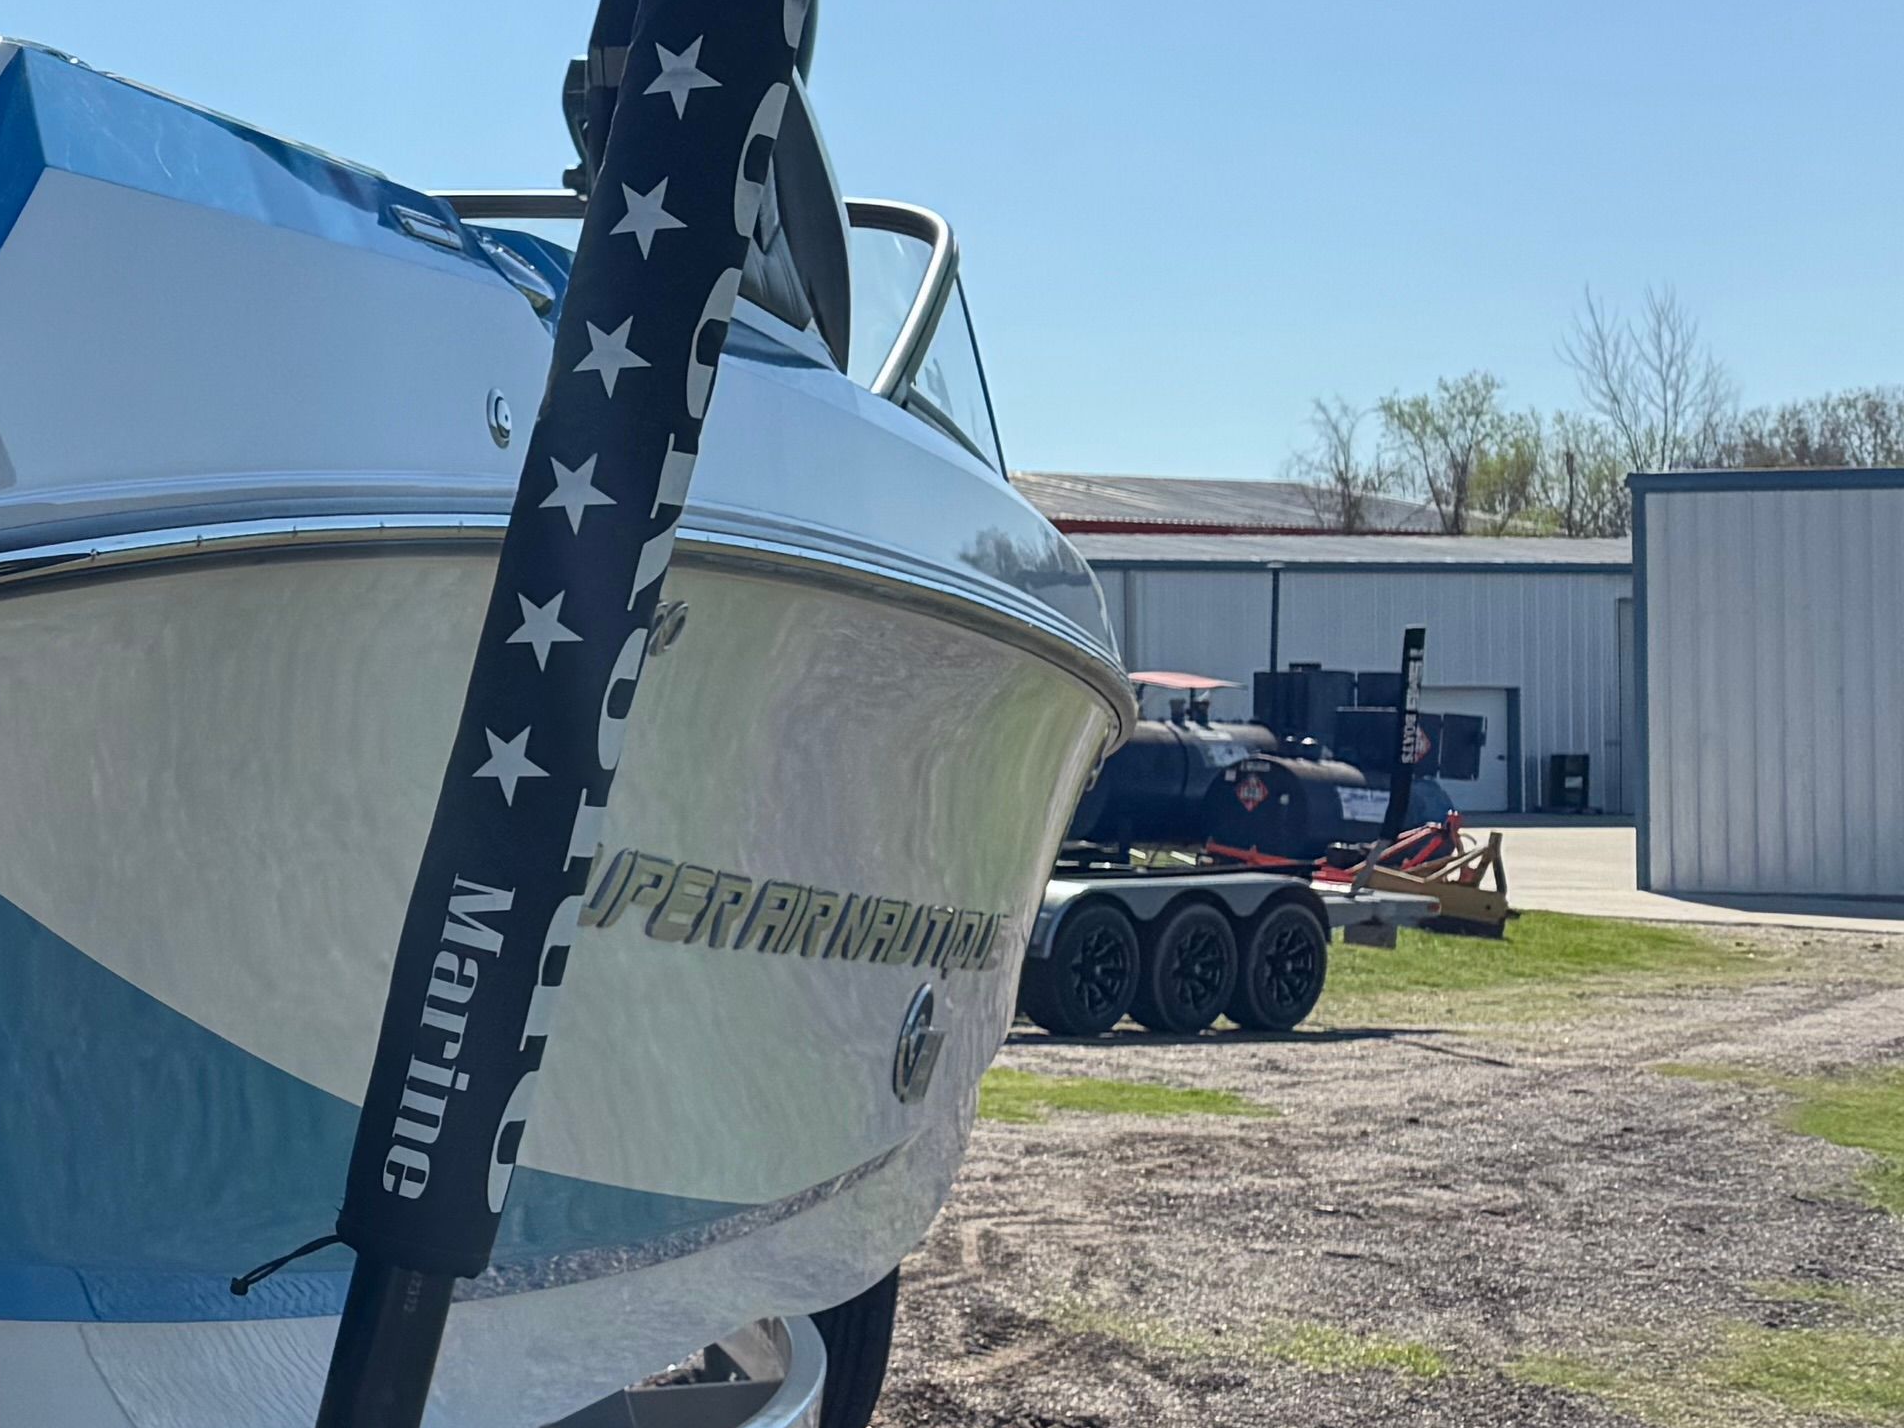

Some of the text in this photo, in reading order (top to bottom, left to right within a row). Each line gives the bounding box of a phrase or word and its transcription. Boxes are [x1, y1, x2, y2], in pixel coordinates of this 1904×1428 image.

[576, 844, 752, 949] UPER
[732, 878, 840, 959] AIR
[822, 892, 1012, 980] NAUTIQU
[382, 872, 515, 1200] Marine
